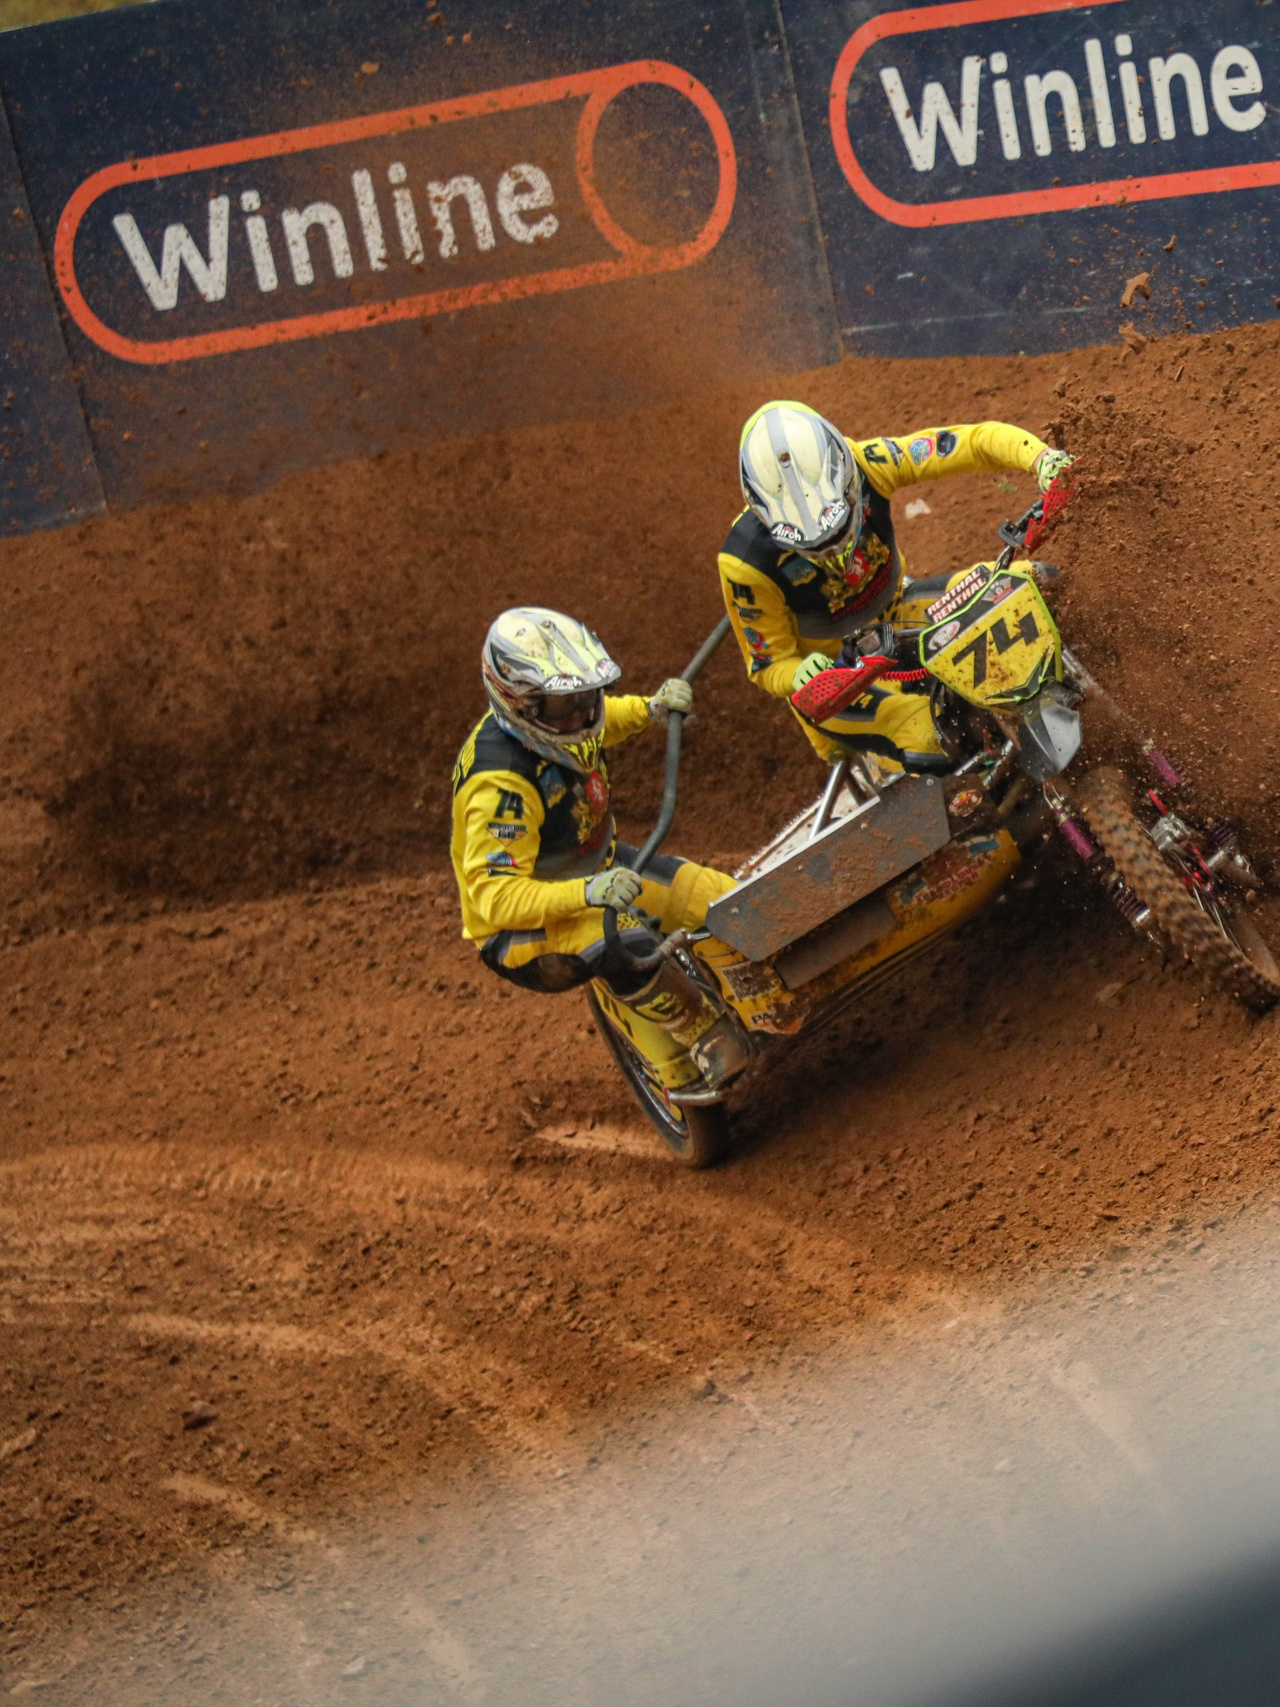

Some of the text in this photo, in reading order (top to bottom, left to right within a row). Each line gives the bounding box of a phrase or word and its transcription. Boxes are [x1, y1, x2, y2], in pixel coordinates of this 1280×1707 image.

[879, 35, 1267, 173] Winline
[113, 162, 559, 311] Winline
[771, 523, 802, 541] Airoh
[927, 568, 981, 616] RENTHAL
[932, 577, 987, 624] RENTHAL
[951, 611, 1040, 689] 74
